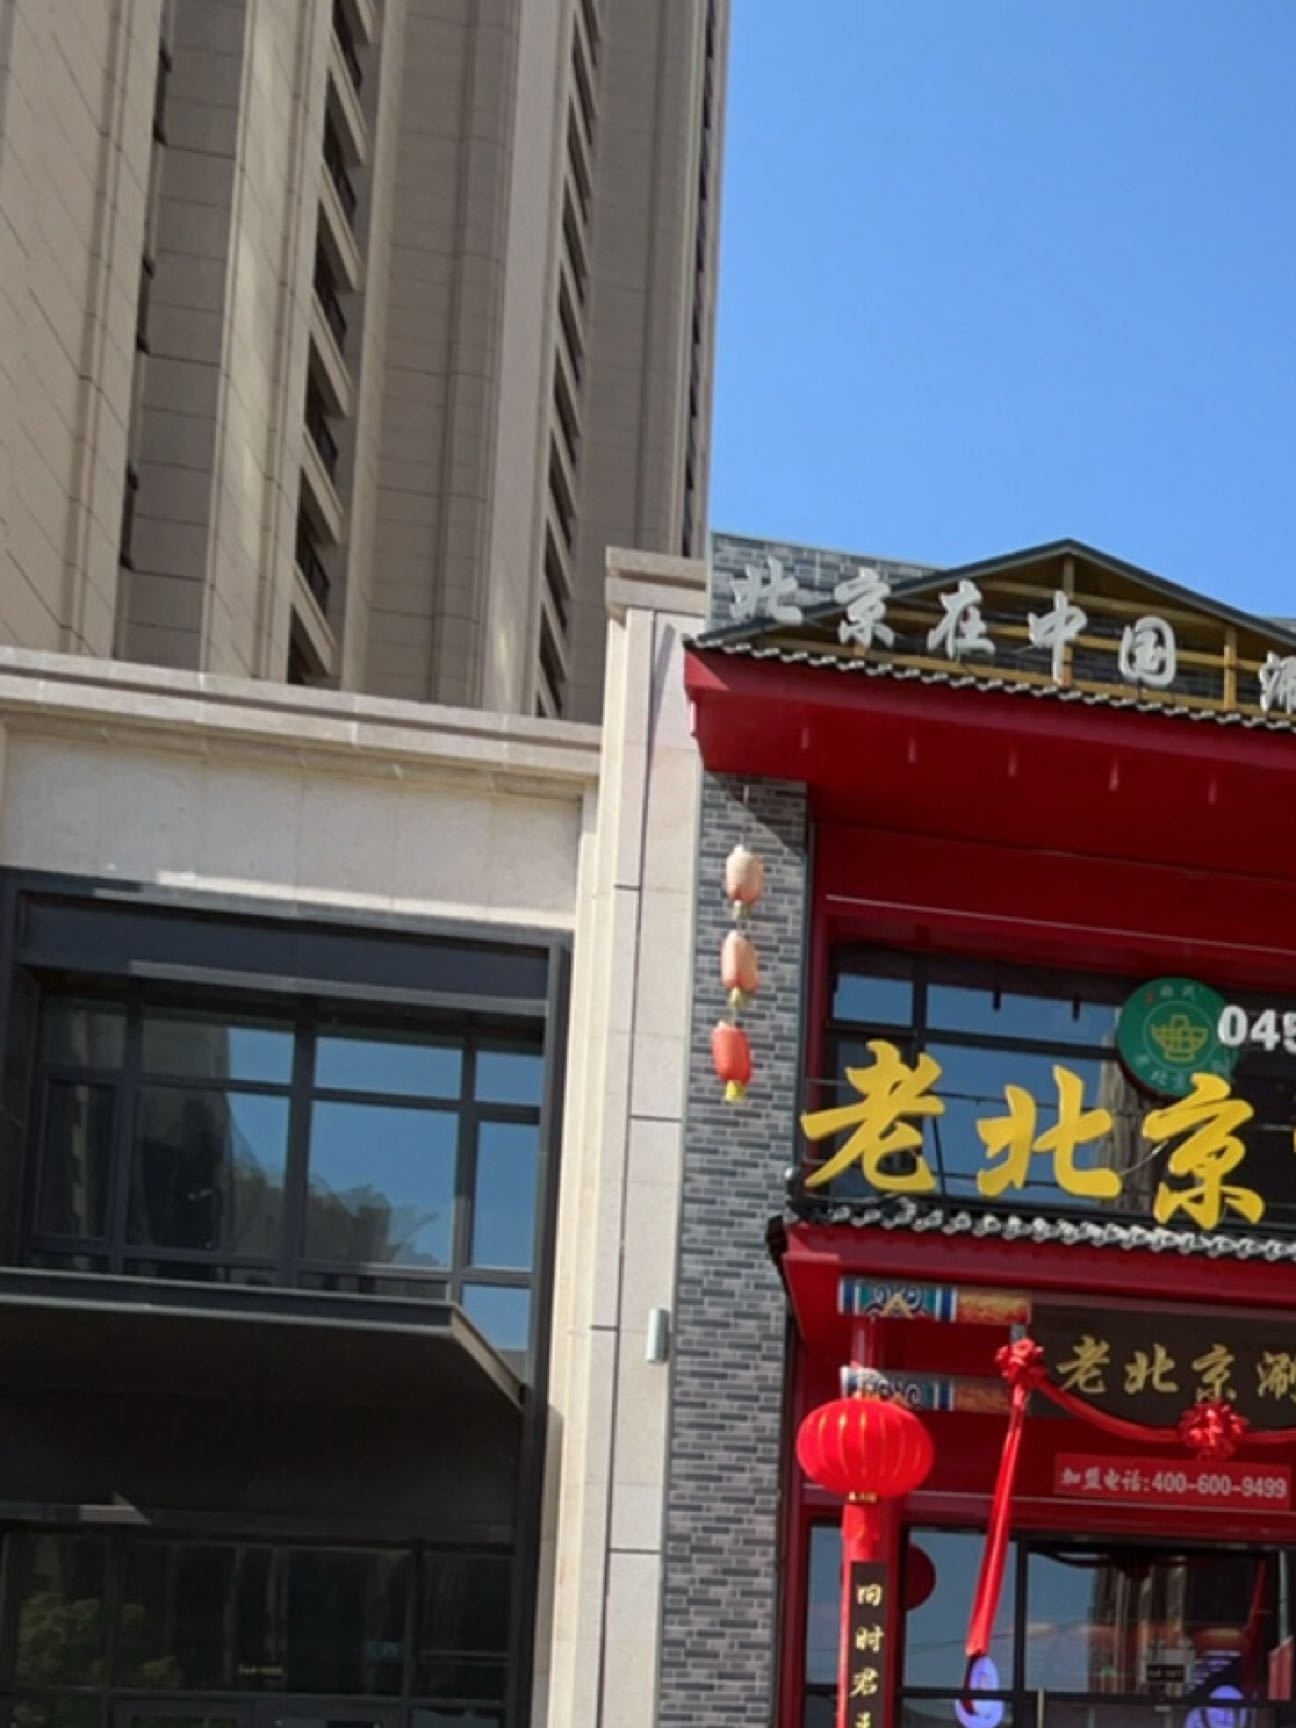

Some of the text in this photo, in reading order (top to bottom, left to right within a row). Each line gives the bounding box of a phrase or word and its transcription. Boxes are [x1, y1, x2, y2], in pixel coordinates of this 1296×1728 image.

[728, 556, 1176, 686] 北京在中国
